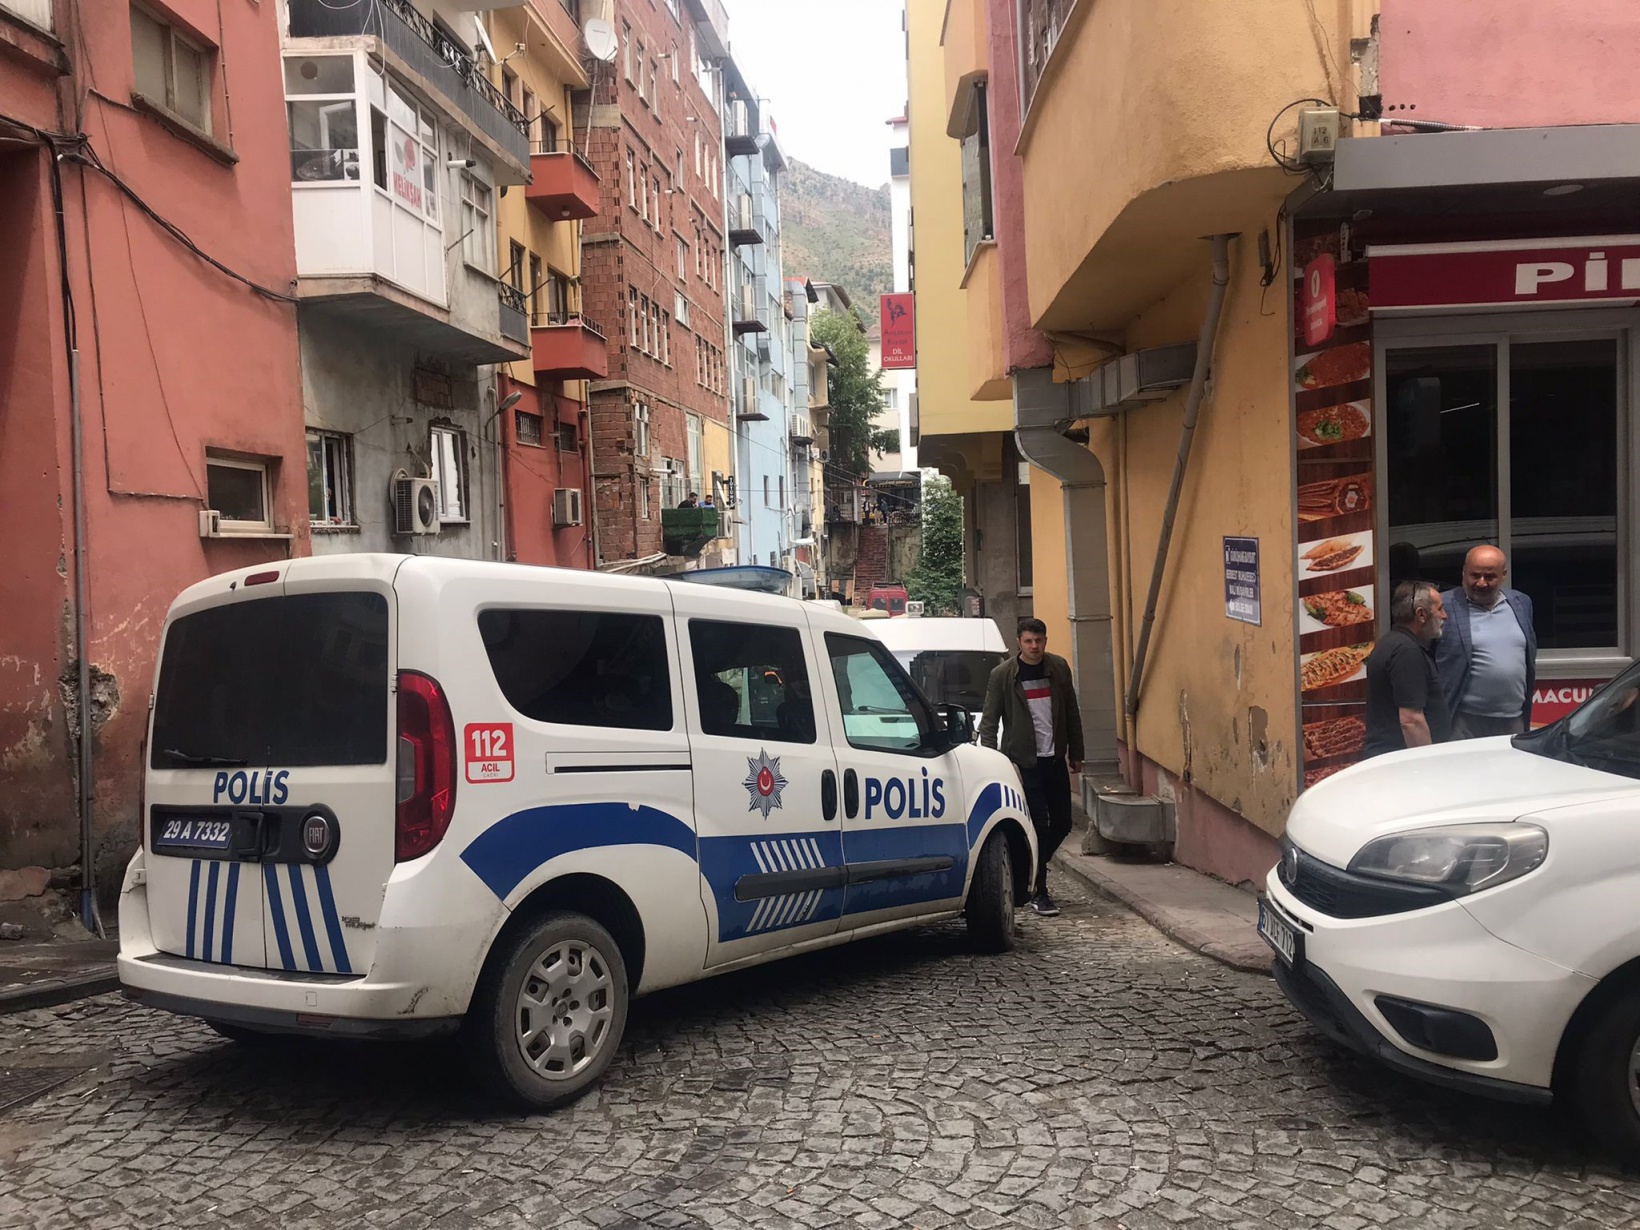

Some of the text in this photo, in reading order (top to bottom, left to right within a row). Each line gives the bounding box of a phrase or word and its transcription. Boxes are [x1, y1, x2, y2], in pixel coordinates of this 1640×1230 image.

[472, 729, 507, 757] 112
[213, 770, 290, 805] POLİS
[865, 766, 946, 820] POLİS
[163, 820, 230, 842] 29 A 7332
[309, 827, 324, 843] FIAT
